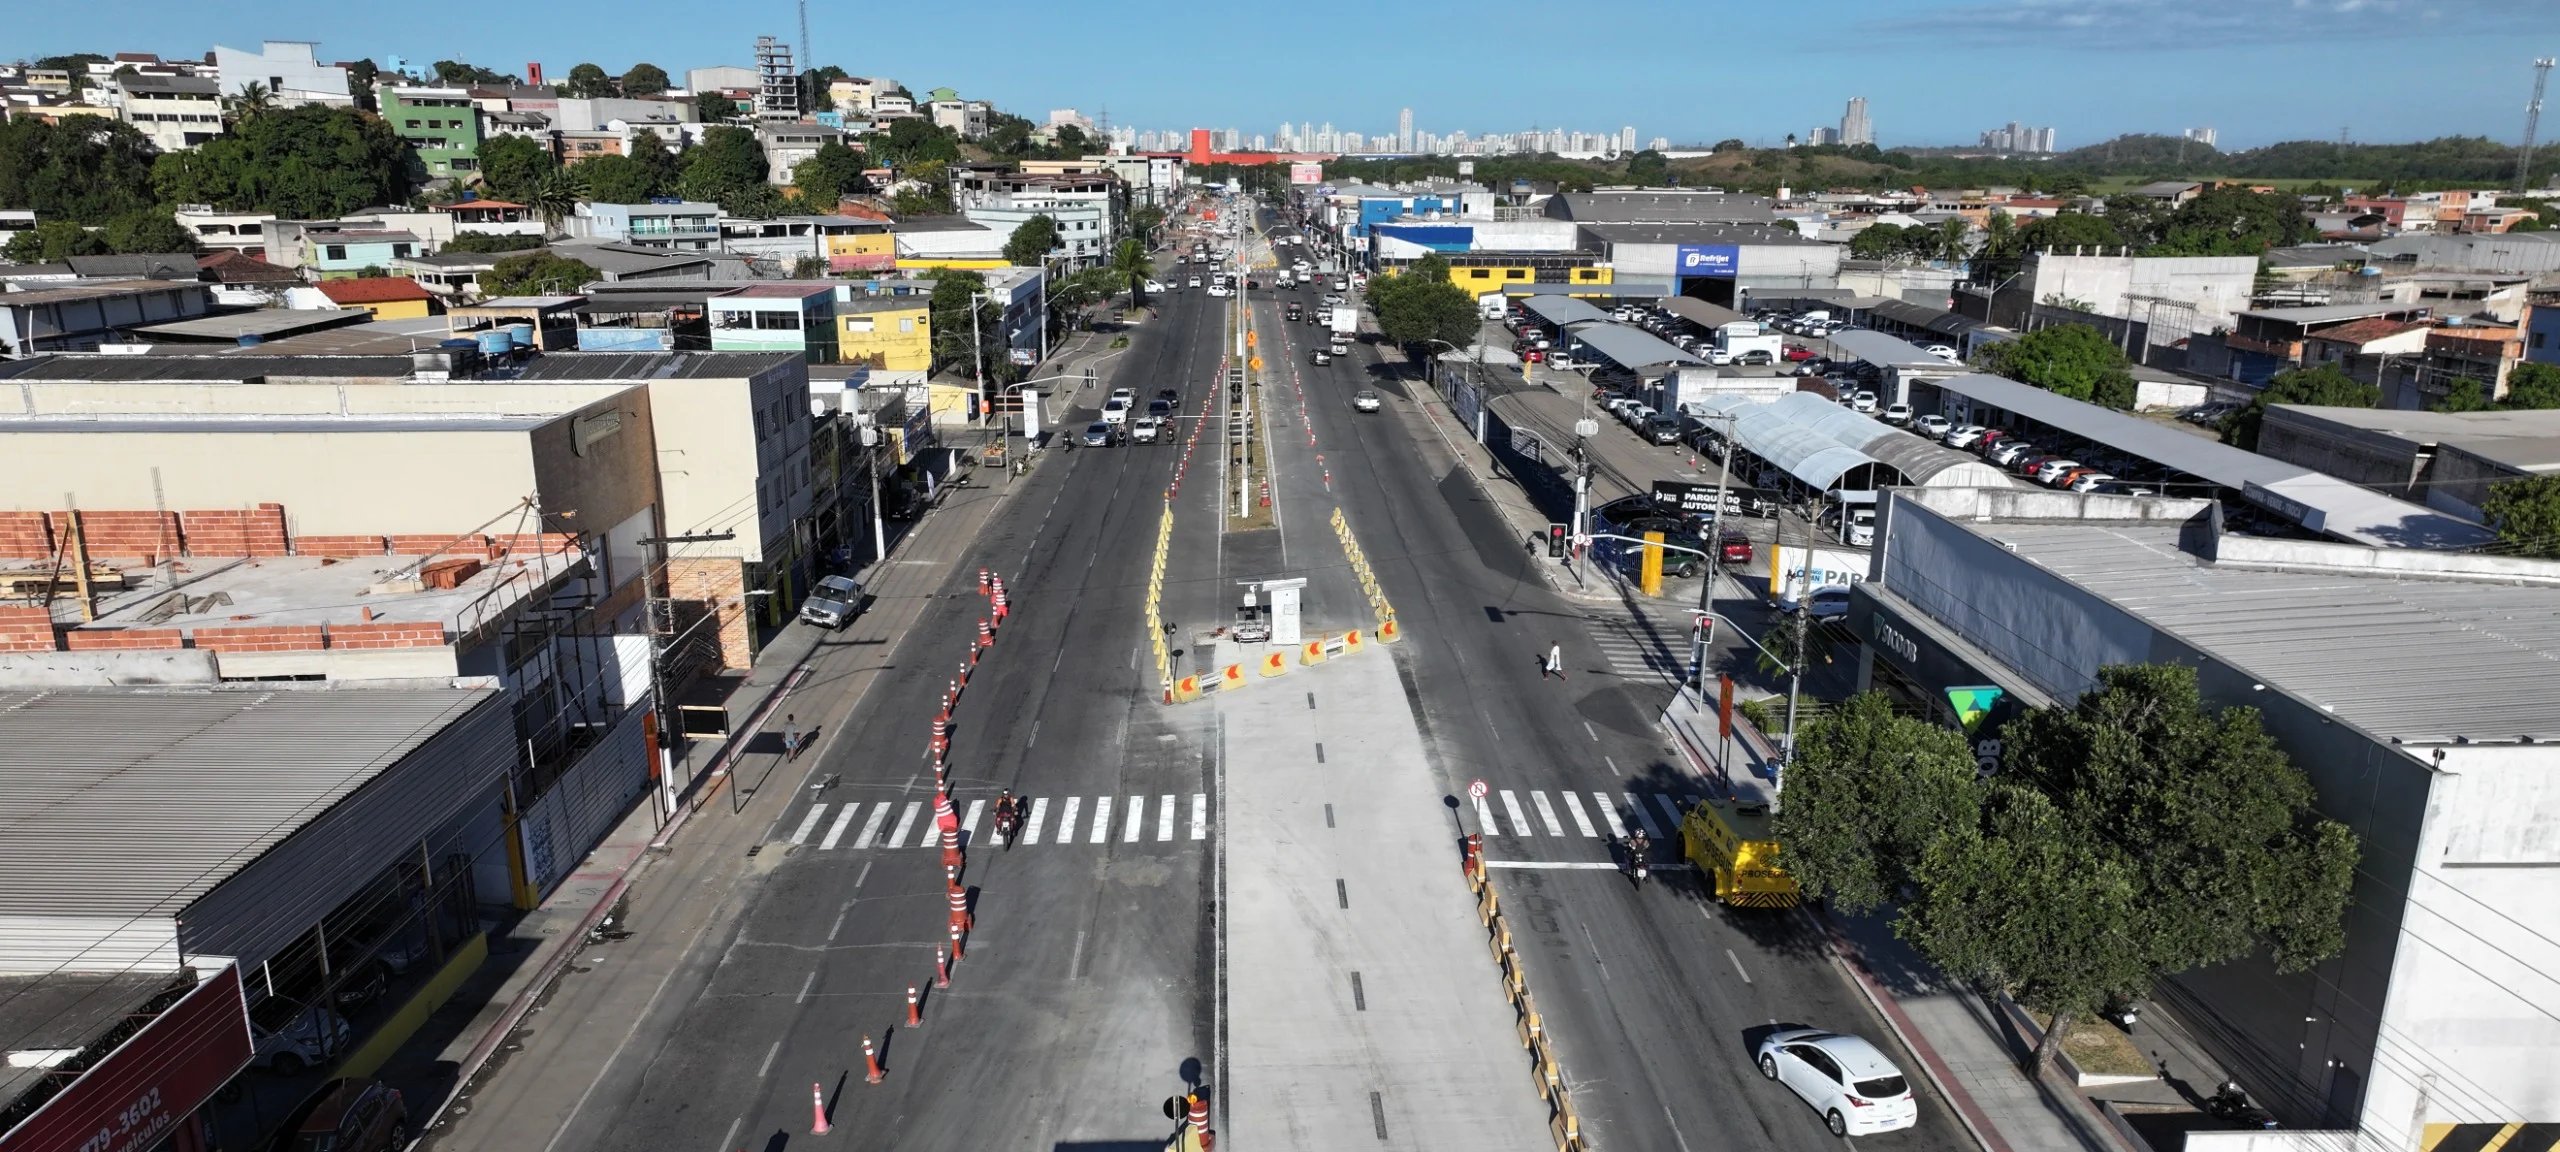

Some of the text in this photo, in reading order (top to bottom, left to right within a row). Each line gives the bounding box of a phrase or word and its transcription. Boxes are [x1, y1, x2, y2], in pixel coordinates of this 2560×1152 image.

[1700, 254, 1729, 264] Refrijet
[1684, 492, 1722, 503] PARQU
[1681, 501, 1742, 513] AUTOMVEL
[1881, 624, 1917, 663] SICOOB
